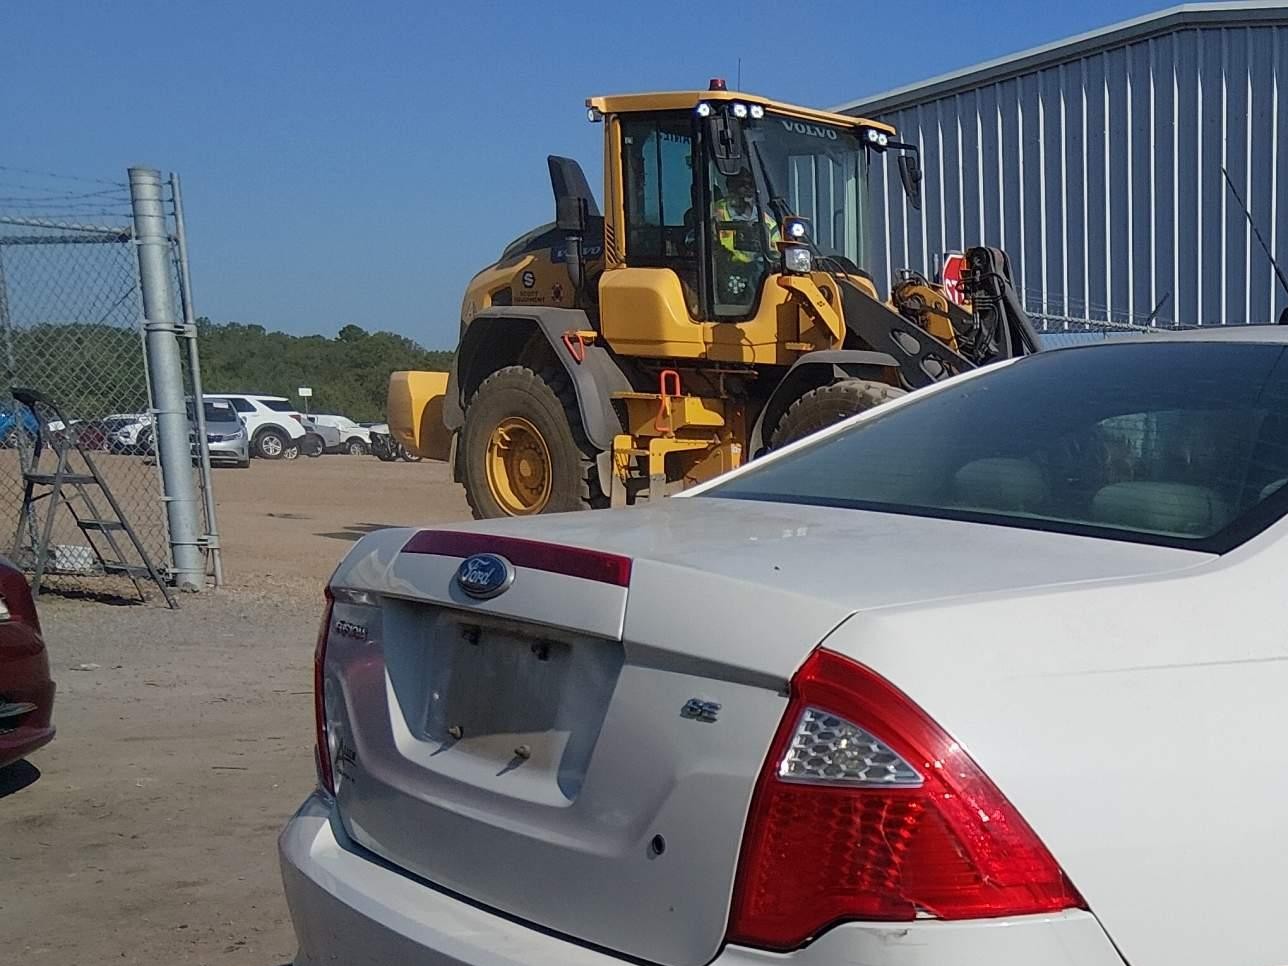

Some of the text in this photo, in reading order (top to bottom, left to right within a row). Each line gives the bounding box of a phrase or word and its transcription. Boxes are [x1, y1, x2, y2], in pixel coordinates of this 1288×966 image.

[781, 120, 838, 141] VOLVO
[557, 246, 602, 257] VVO
[461, 557, 496, 585] Ford
[685, 697, 722, 720] SE
